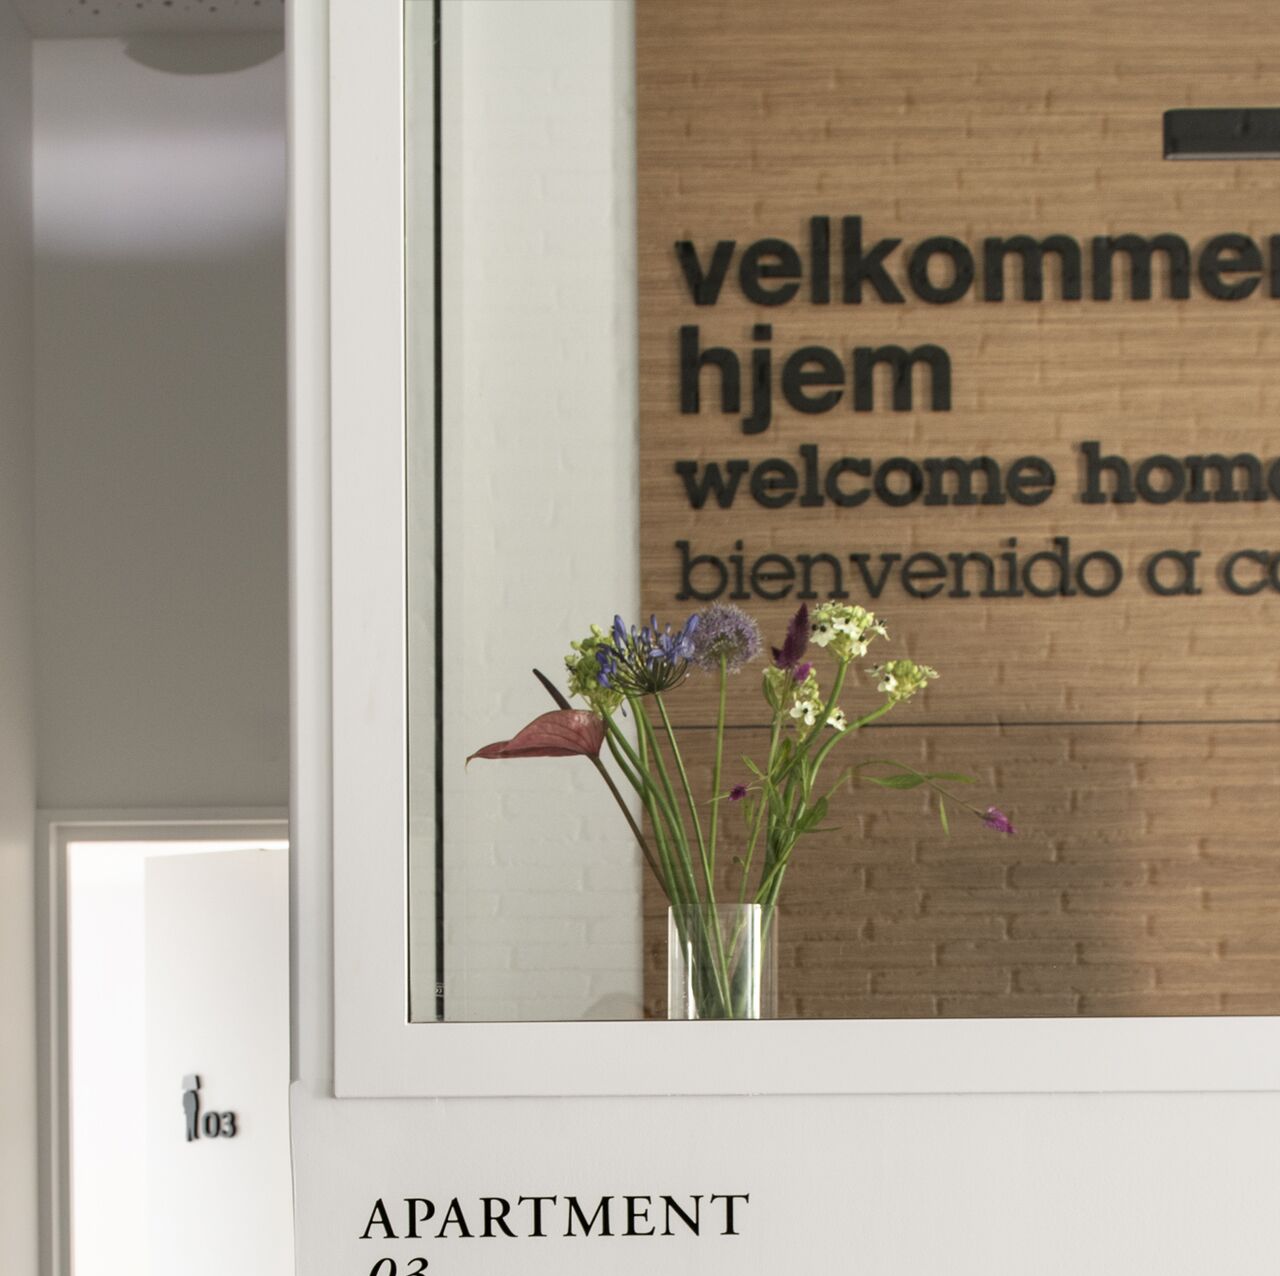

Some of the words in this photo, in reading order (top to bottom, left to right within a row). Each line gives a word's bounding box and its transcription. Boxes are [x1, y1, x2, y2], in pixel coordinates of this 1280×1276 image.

[679, 323, 952, 435] hjem
[674, 443, 1057, 509] welcome
[674, 537, 1124, 600] bienvenido
[1146, 549, 1202, 597] a
[202, 1110, 238, 1138] 03
[359, 1192, 750, 1240] APARTMENT
